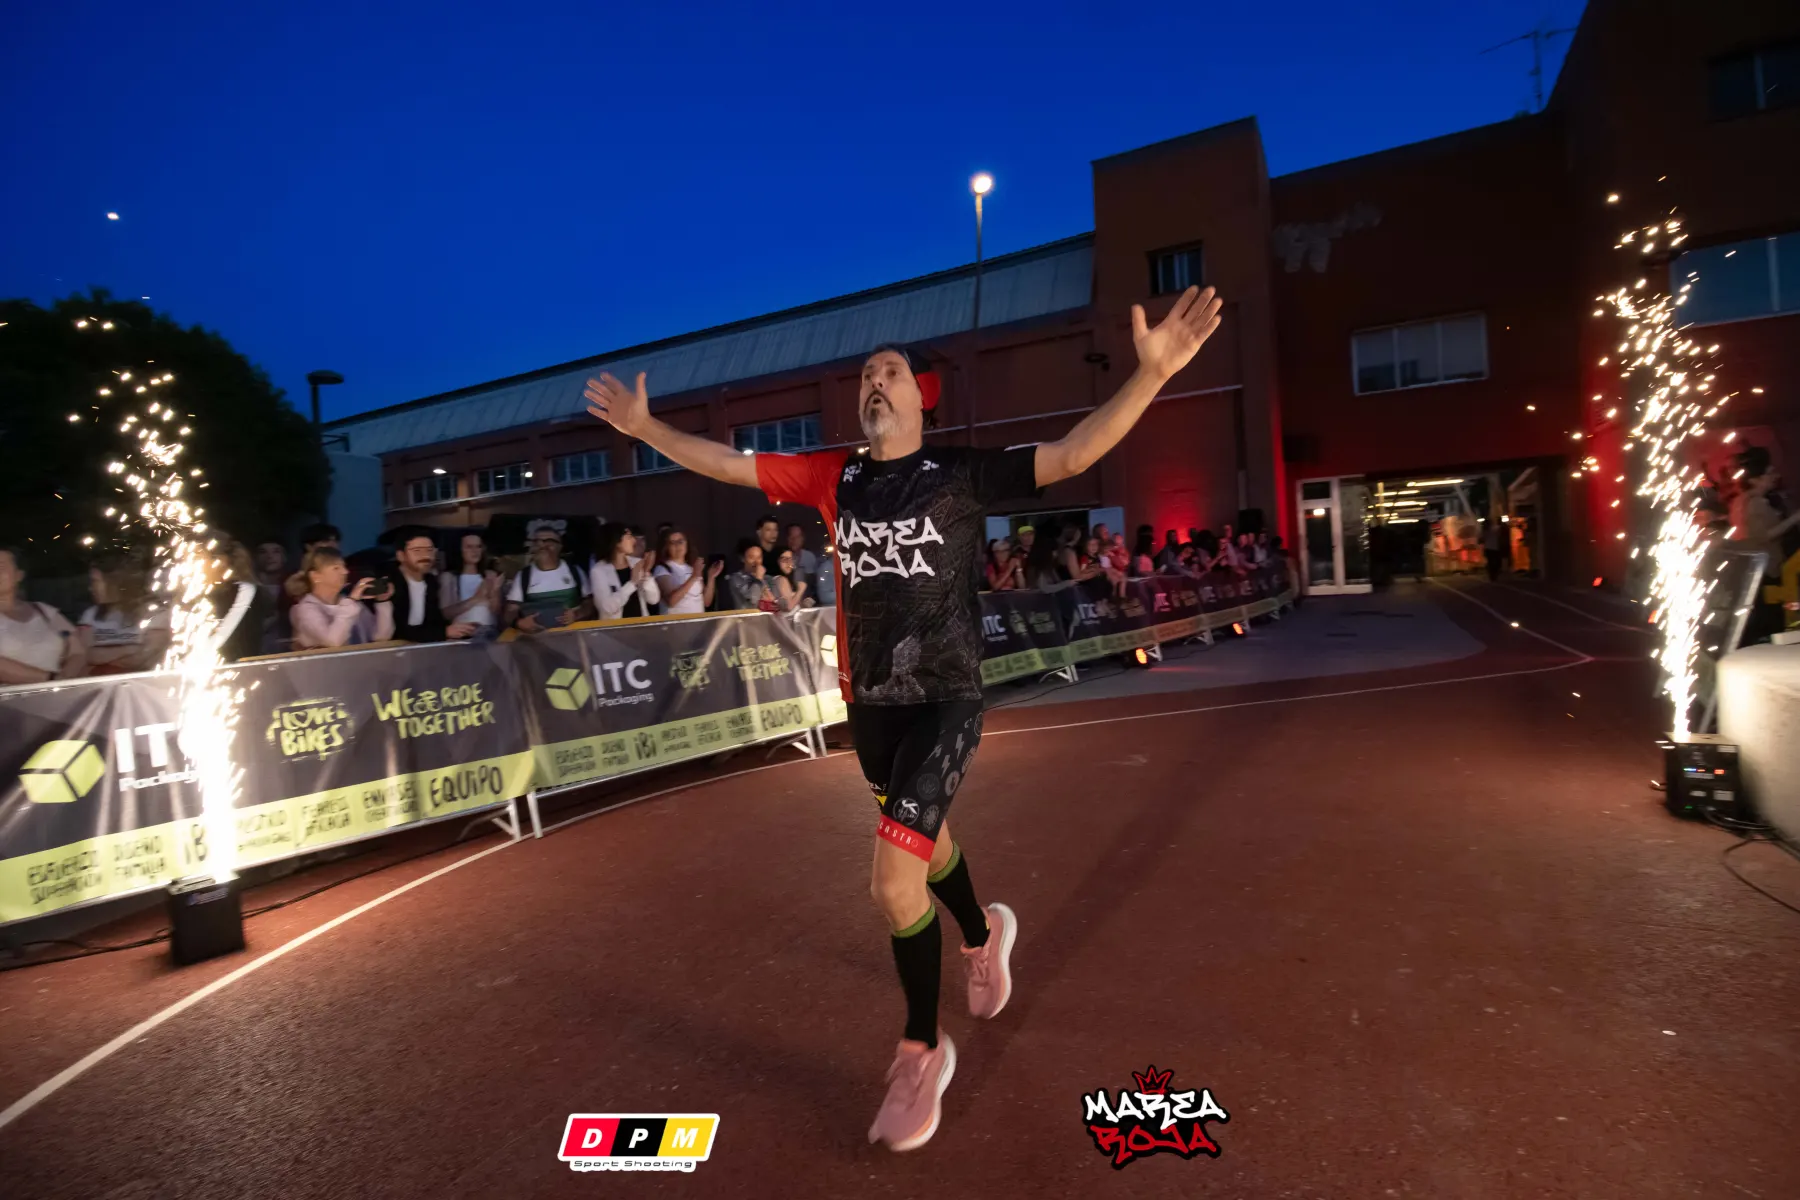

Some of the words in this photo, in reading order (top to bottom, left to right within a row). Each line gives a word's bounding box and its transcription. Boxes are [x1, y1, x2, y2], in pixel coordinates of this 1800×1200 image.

[833, 516, 944, 561] MAREA
[838, 549, 935, 588] ROJA
[592, 659, 652, 694] ITC
[371, 687, 416, 721] WE
[440, 683, 484, 705] RiDE
[598, 692, 655, 707] Packaging
[396, 701, 496, 739] TOGETHER
[280, 723, 344, 756] BiKES
